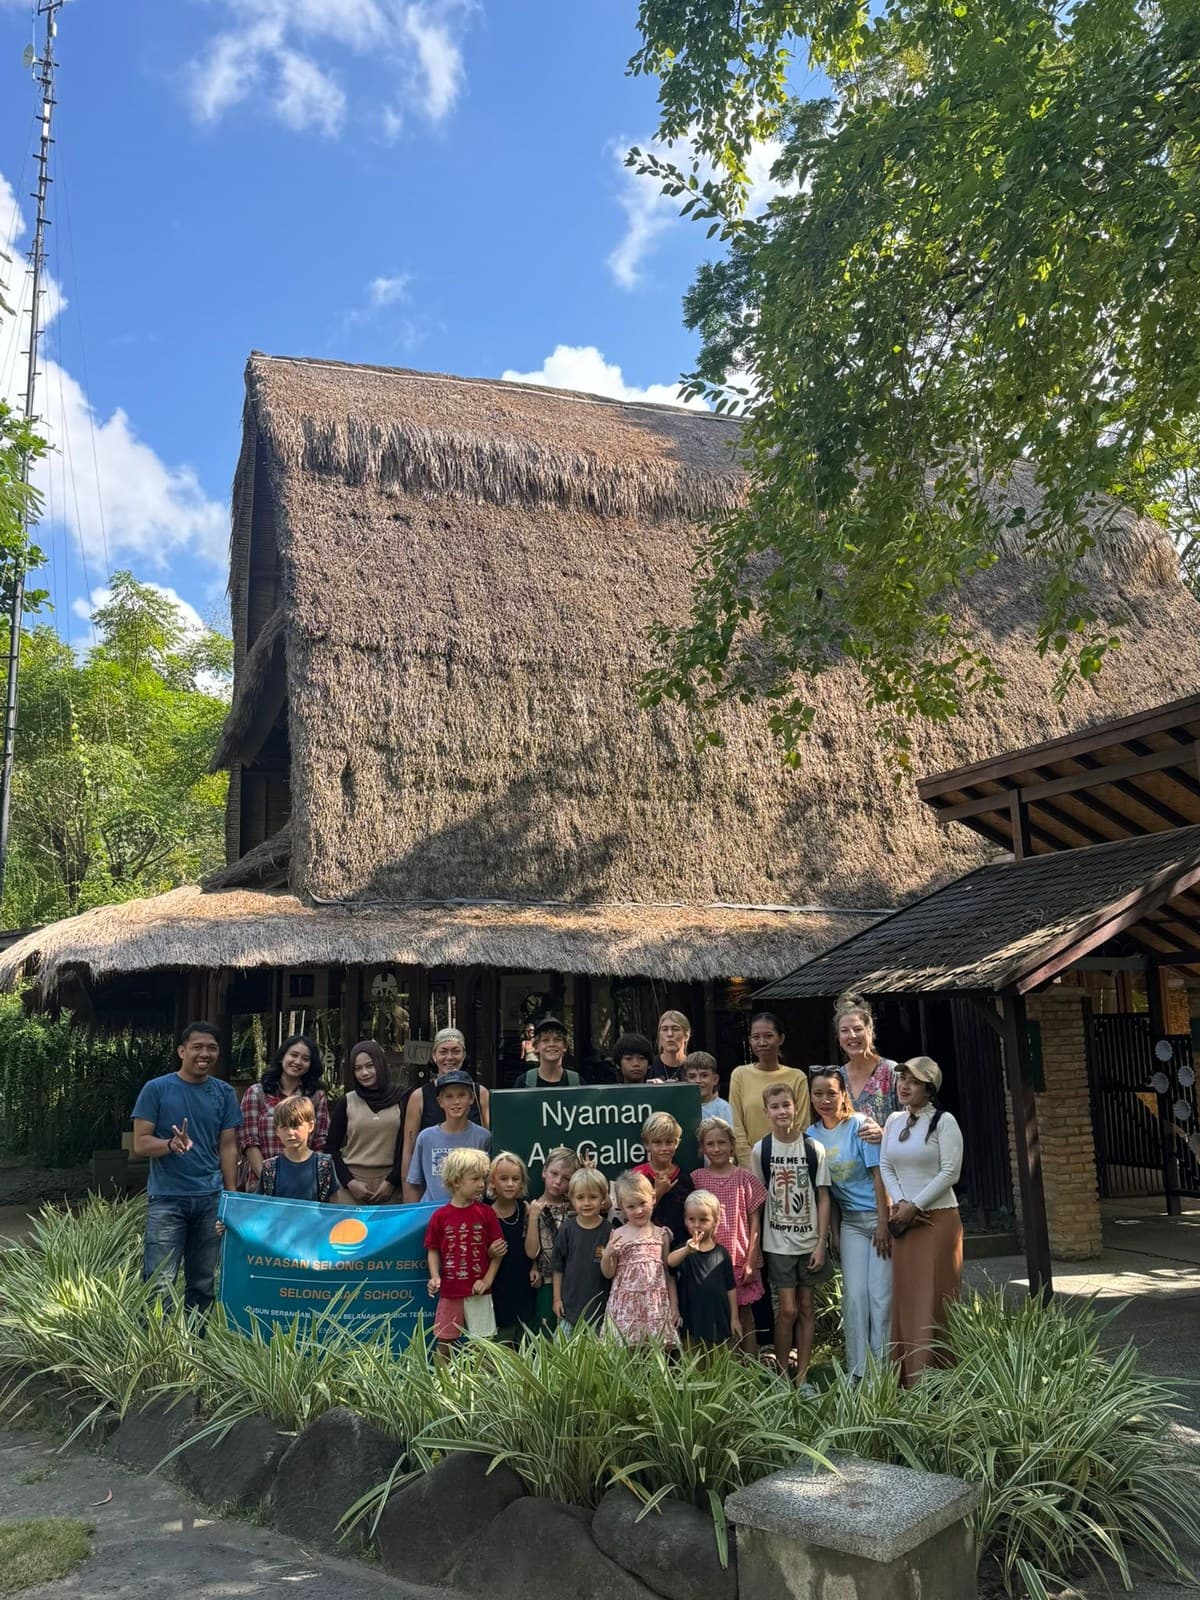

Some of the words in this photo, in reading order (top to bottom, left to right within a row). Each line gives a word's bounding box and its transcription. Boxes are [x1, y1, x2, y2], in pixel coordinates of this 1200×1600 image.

[542, 1101, 652, 1131] Nyaman
[787, 1156, 798, 1164] ME
[794, 1224, 813, 1233] DAYS
[247, 1255, 309, 1270] YAYASAN
[312, 1260, 364, 1271] SELONG
[367, 1260, 393, 1271] BAY
[279, 1287, 331, 1300] SELONG
[364, 1289, 412, 1301] SCHOOL
